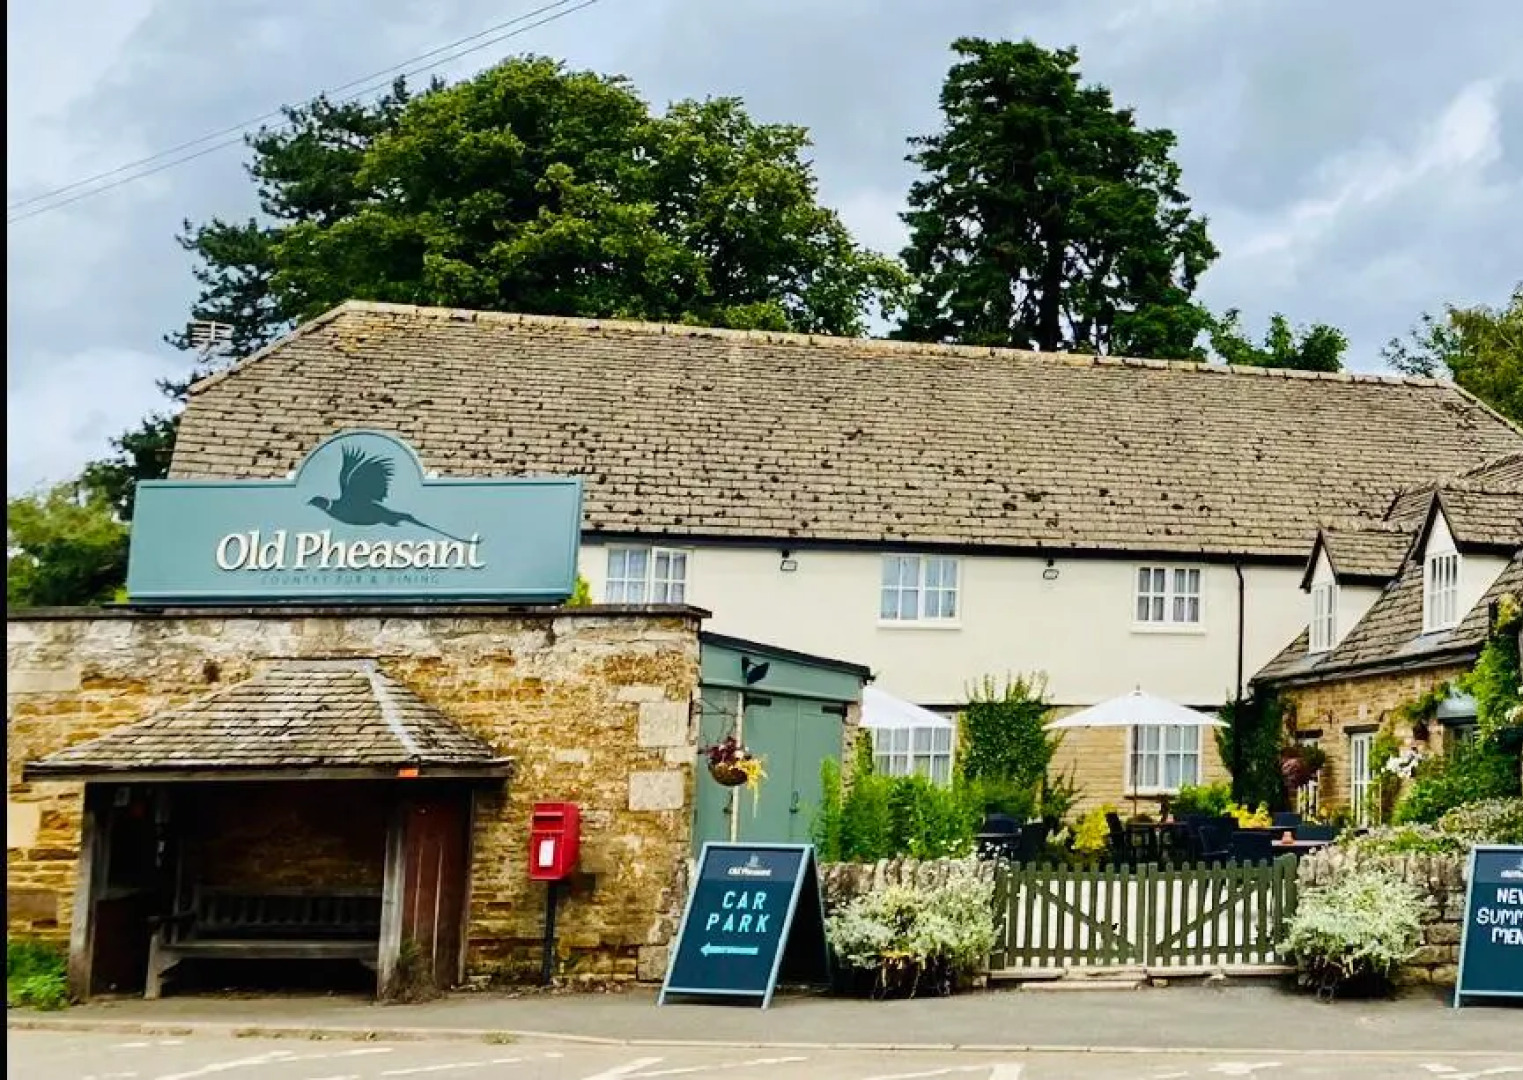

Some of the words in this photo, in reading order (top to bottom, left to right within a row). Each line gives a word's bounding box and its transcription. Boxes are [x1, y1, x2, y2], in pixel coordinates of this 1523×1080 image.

[215, 529, 287, 571] Old
[295, 529, 487, 571] Pheasant
[261, 574, 328, 586] COUNTRY
[388, 574, 440, 585] DINING
[722, 890, 767, 910] CAR
[705, 913, 770, 933] PARK
